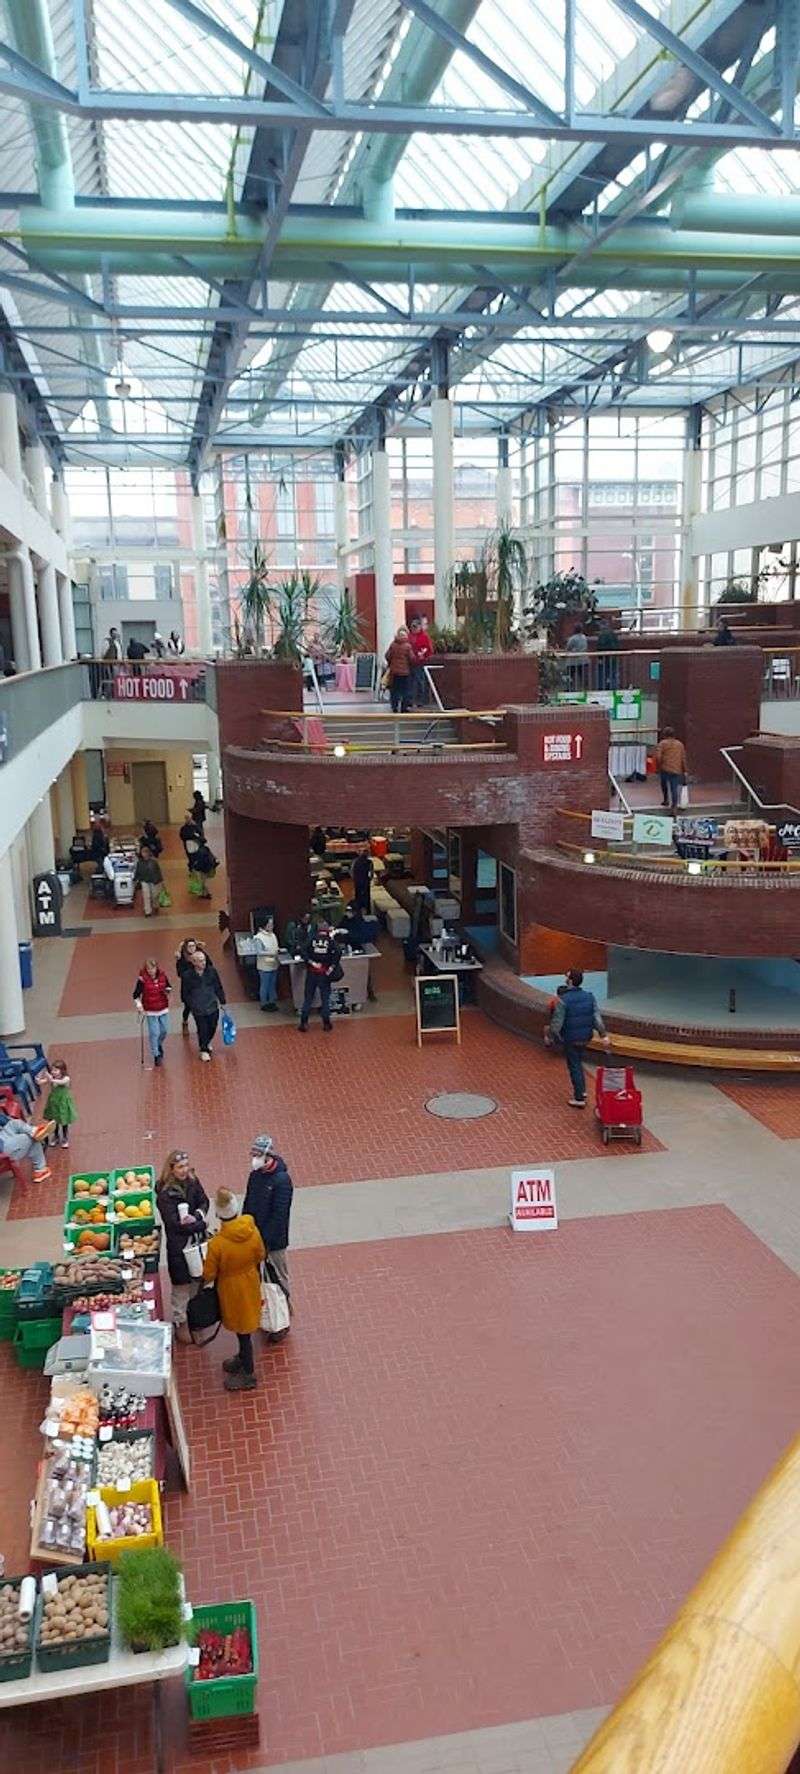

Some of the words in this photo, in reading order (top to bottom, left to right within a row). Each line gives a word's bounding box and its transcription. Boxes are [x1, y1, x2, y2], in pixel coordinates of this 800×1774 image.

[117, 678, 140, 698] HOT
[142, 678, 174, 698] FOOD
[38, 880, 55, 925] ATM
[517, 1180, 551, 1202] ATM
